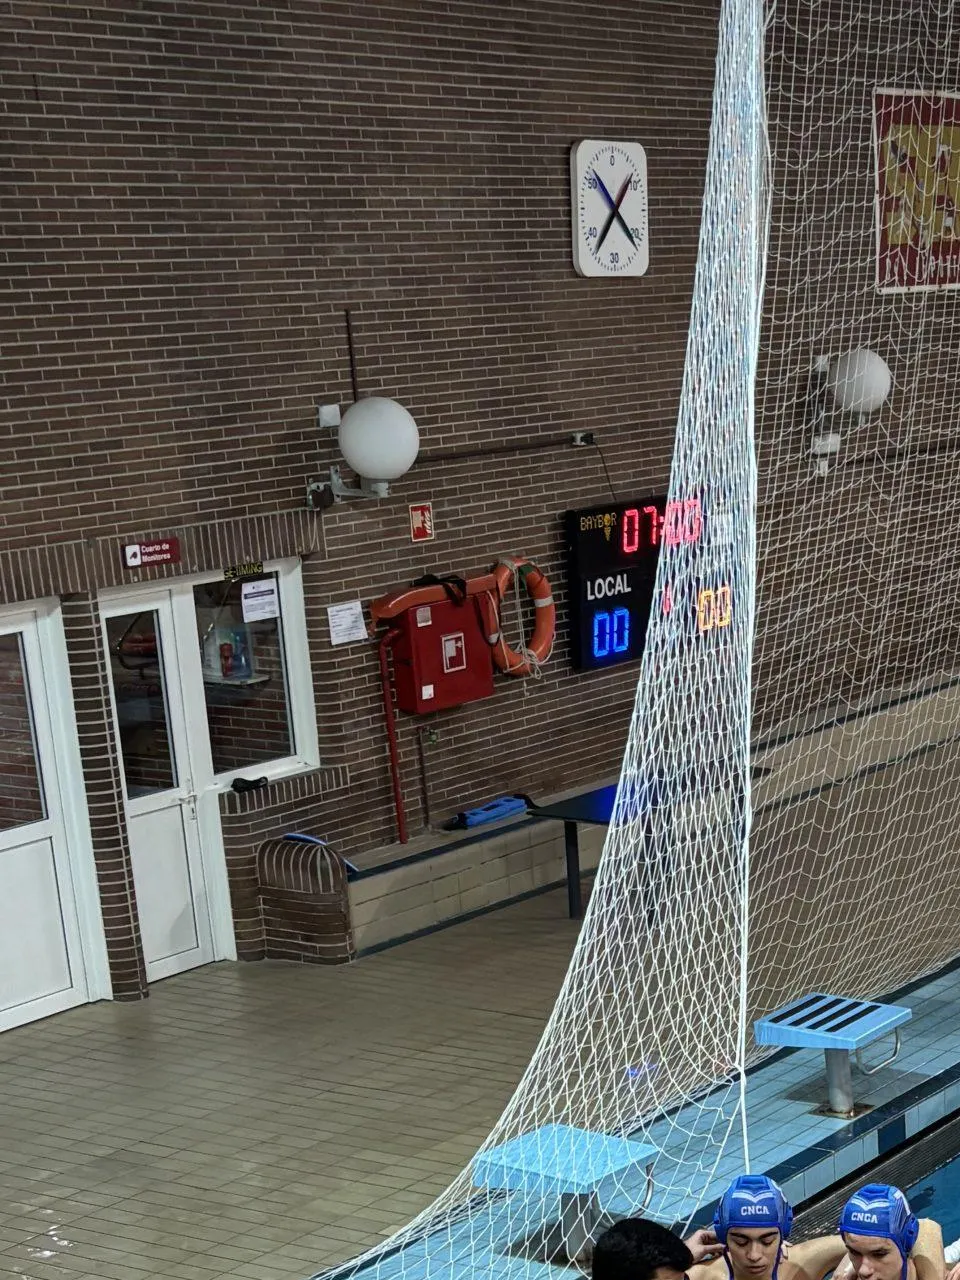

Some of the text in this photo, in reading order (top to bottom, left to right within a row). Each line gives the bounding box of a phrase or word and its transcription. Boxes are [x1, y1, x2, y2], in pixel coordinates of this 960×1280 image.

[610, 155, 615, 166] 0
[588, 227, 597, 238] 40
[610, 253, 619, 264] 30
[587, 573, 632, 601] LOCAL
[698, 584, 731, 631] 00
[594, 607, 629, 658] 00
[740, 1205, 770, 1216] CNCA
[851, 1212, 878, 1224] CNCA
